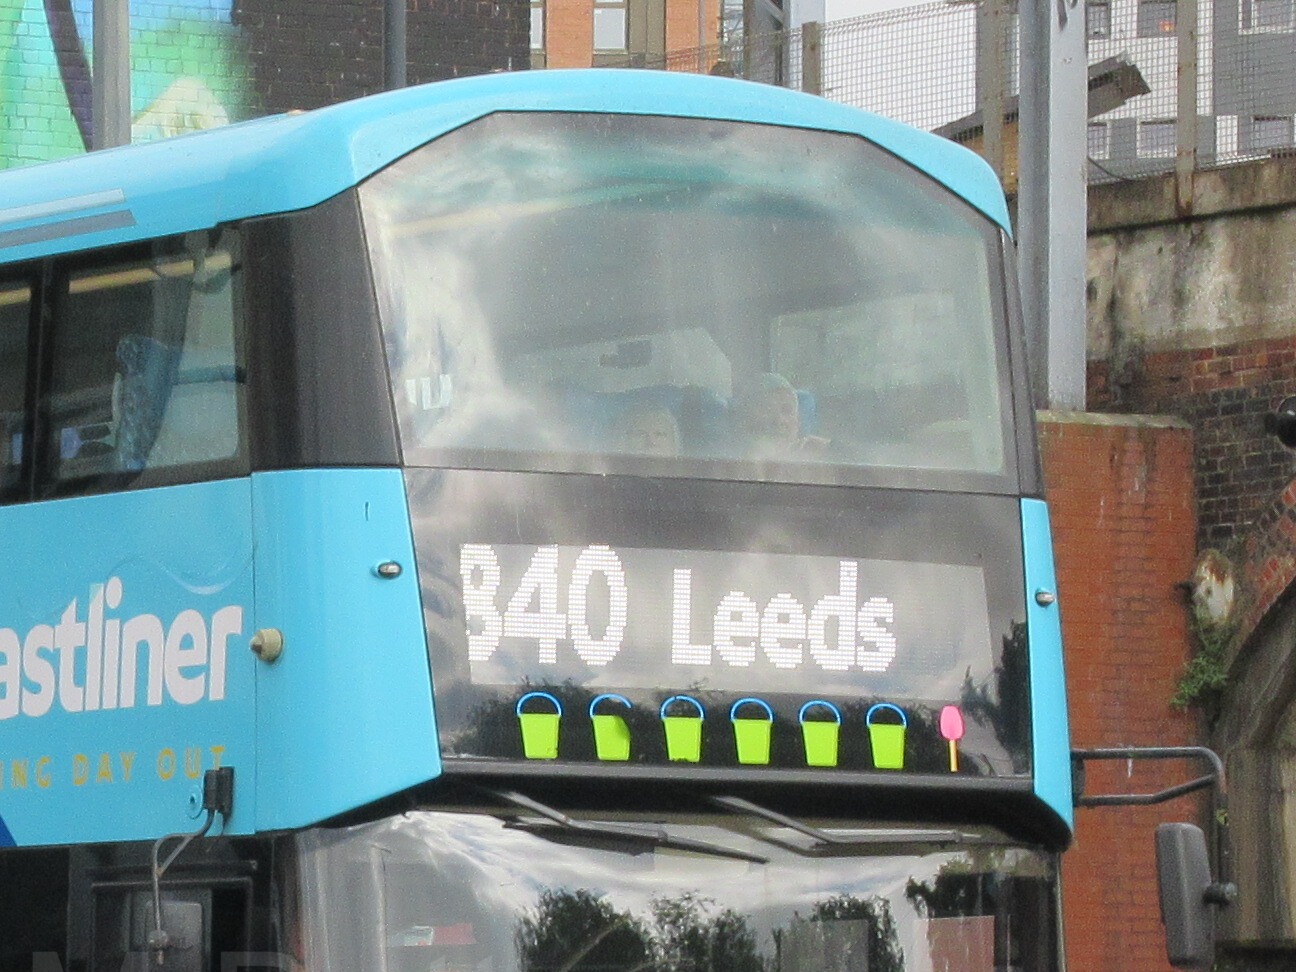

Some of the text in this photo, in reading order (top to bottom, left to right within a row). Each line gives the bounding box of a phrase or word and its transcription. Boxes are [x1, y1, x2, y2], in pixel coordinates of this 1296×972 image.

[671, 561, 896, 671] Leeds
[71, 751, 136, 787] DAY
[157, 744, 225, 781] OUT
